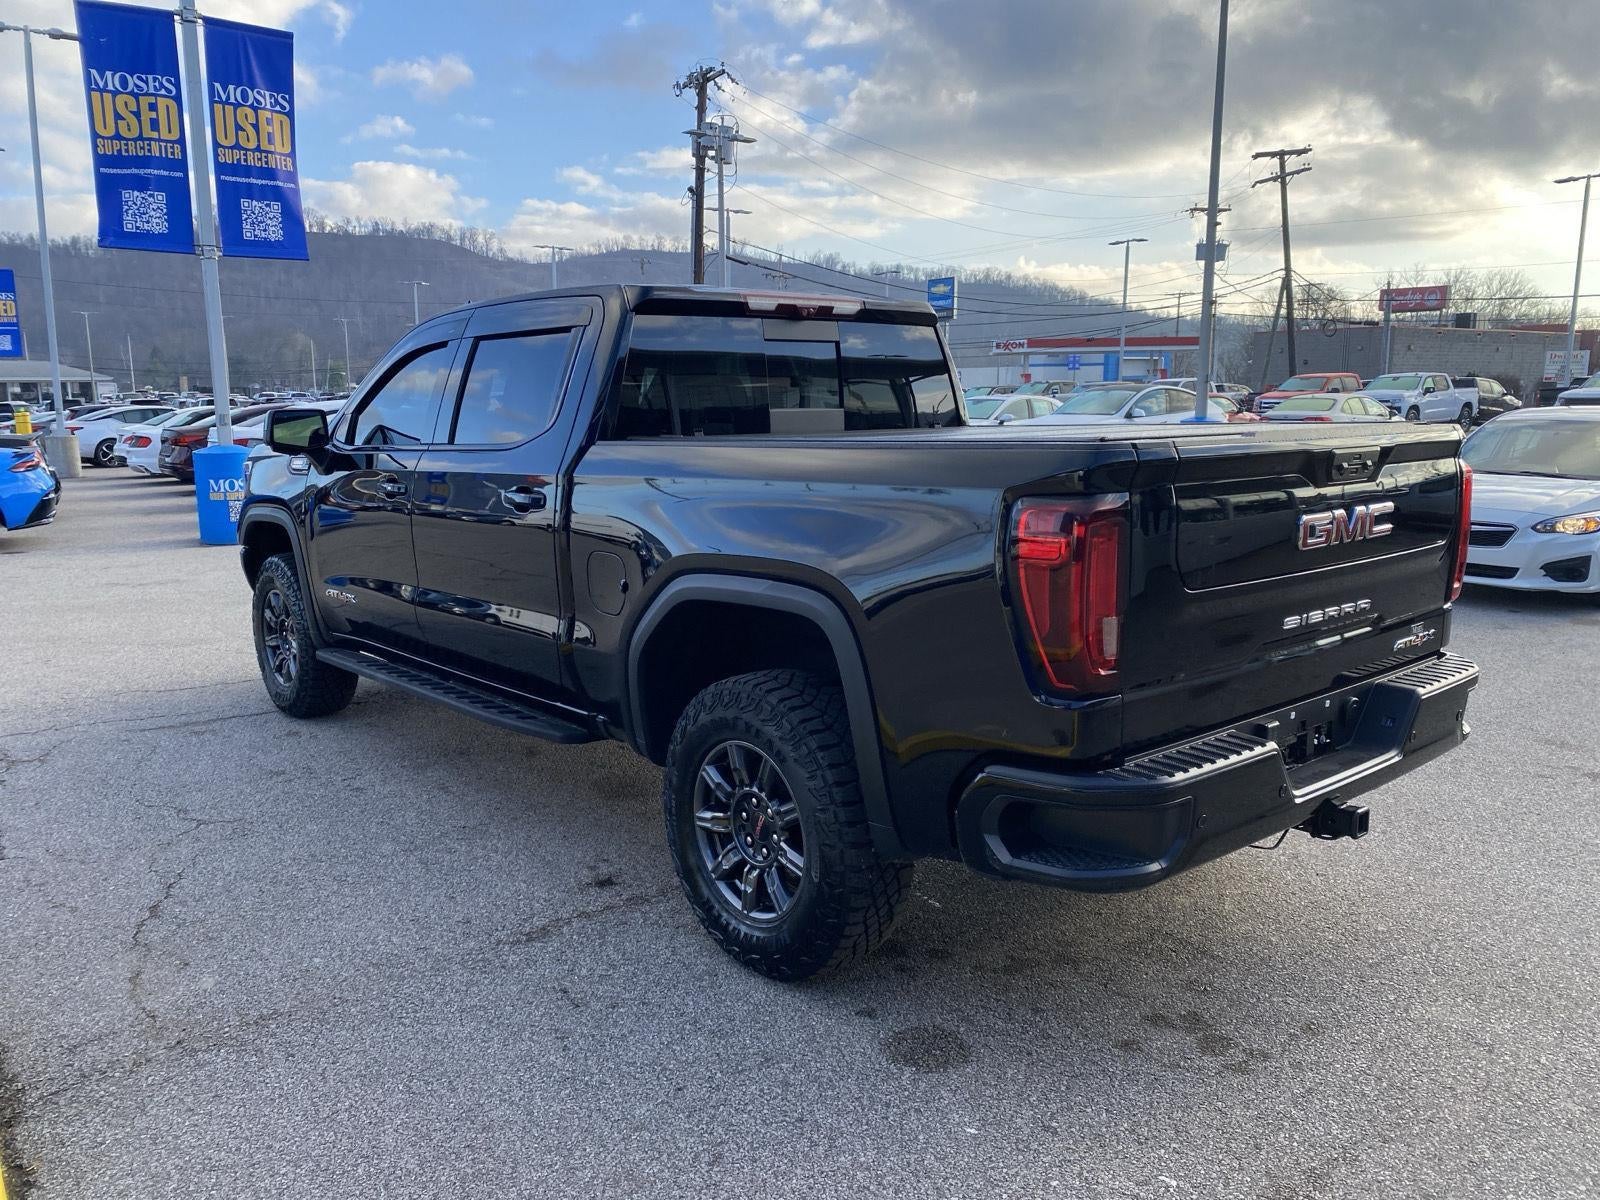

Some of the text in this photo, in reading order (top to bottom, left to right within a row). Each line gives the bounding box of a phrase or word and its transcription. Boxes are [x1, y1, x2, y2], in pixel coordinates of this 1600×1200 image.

[88, 68, 177, 96] MOSES
[213, 82, 290, 112] MOSES
[90, 91, 180, 141] USED
[213, 103, 292, 154] USED
[97, 138, 182, 160] SUPERCENTER
[217, 147, 294, 172] SUPERCENTER
[99, 167, 184, 178] mosesusedsupercenter.com
[995, 340, 1025, 351] EXXON
[1298, 501, 1395, 551] GMC
[1282, 599, 1372, 630] SIERRA
